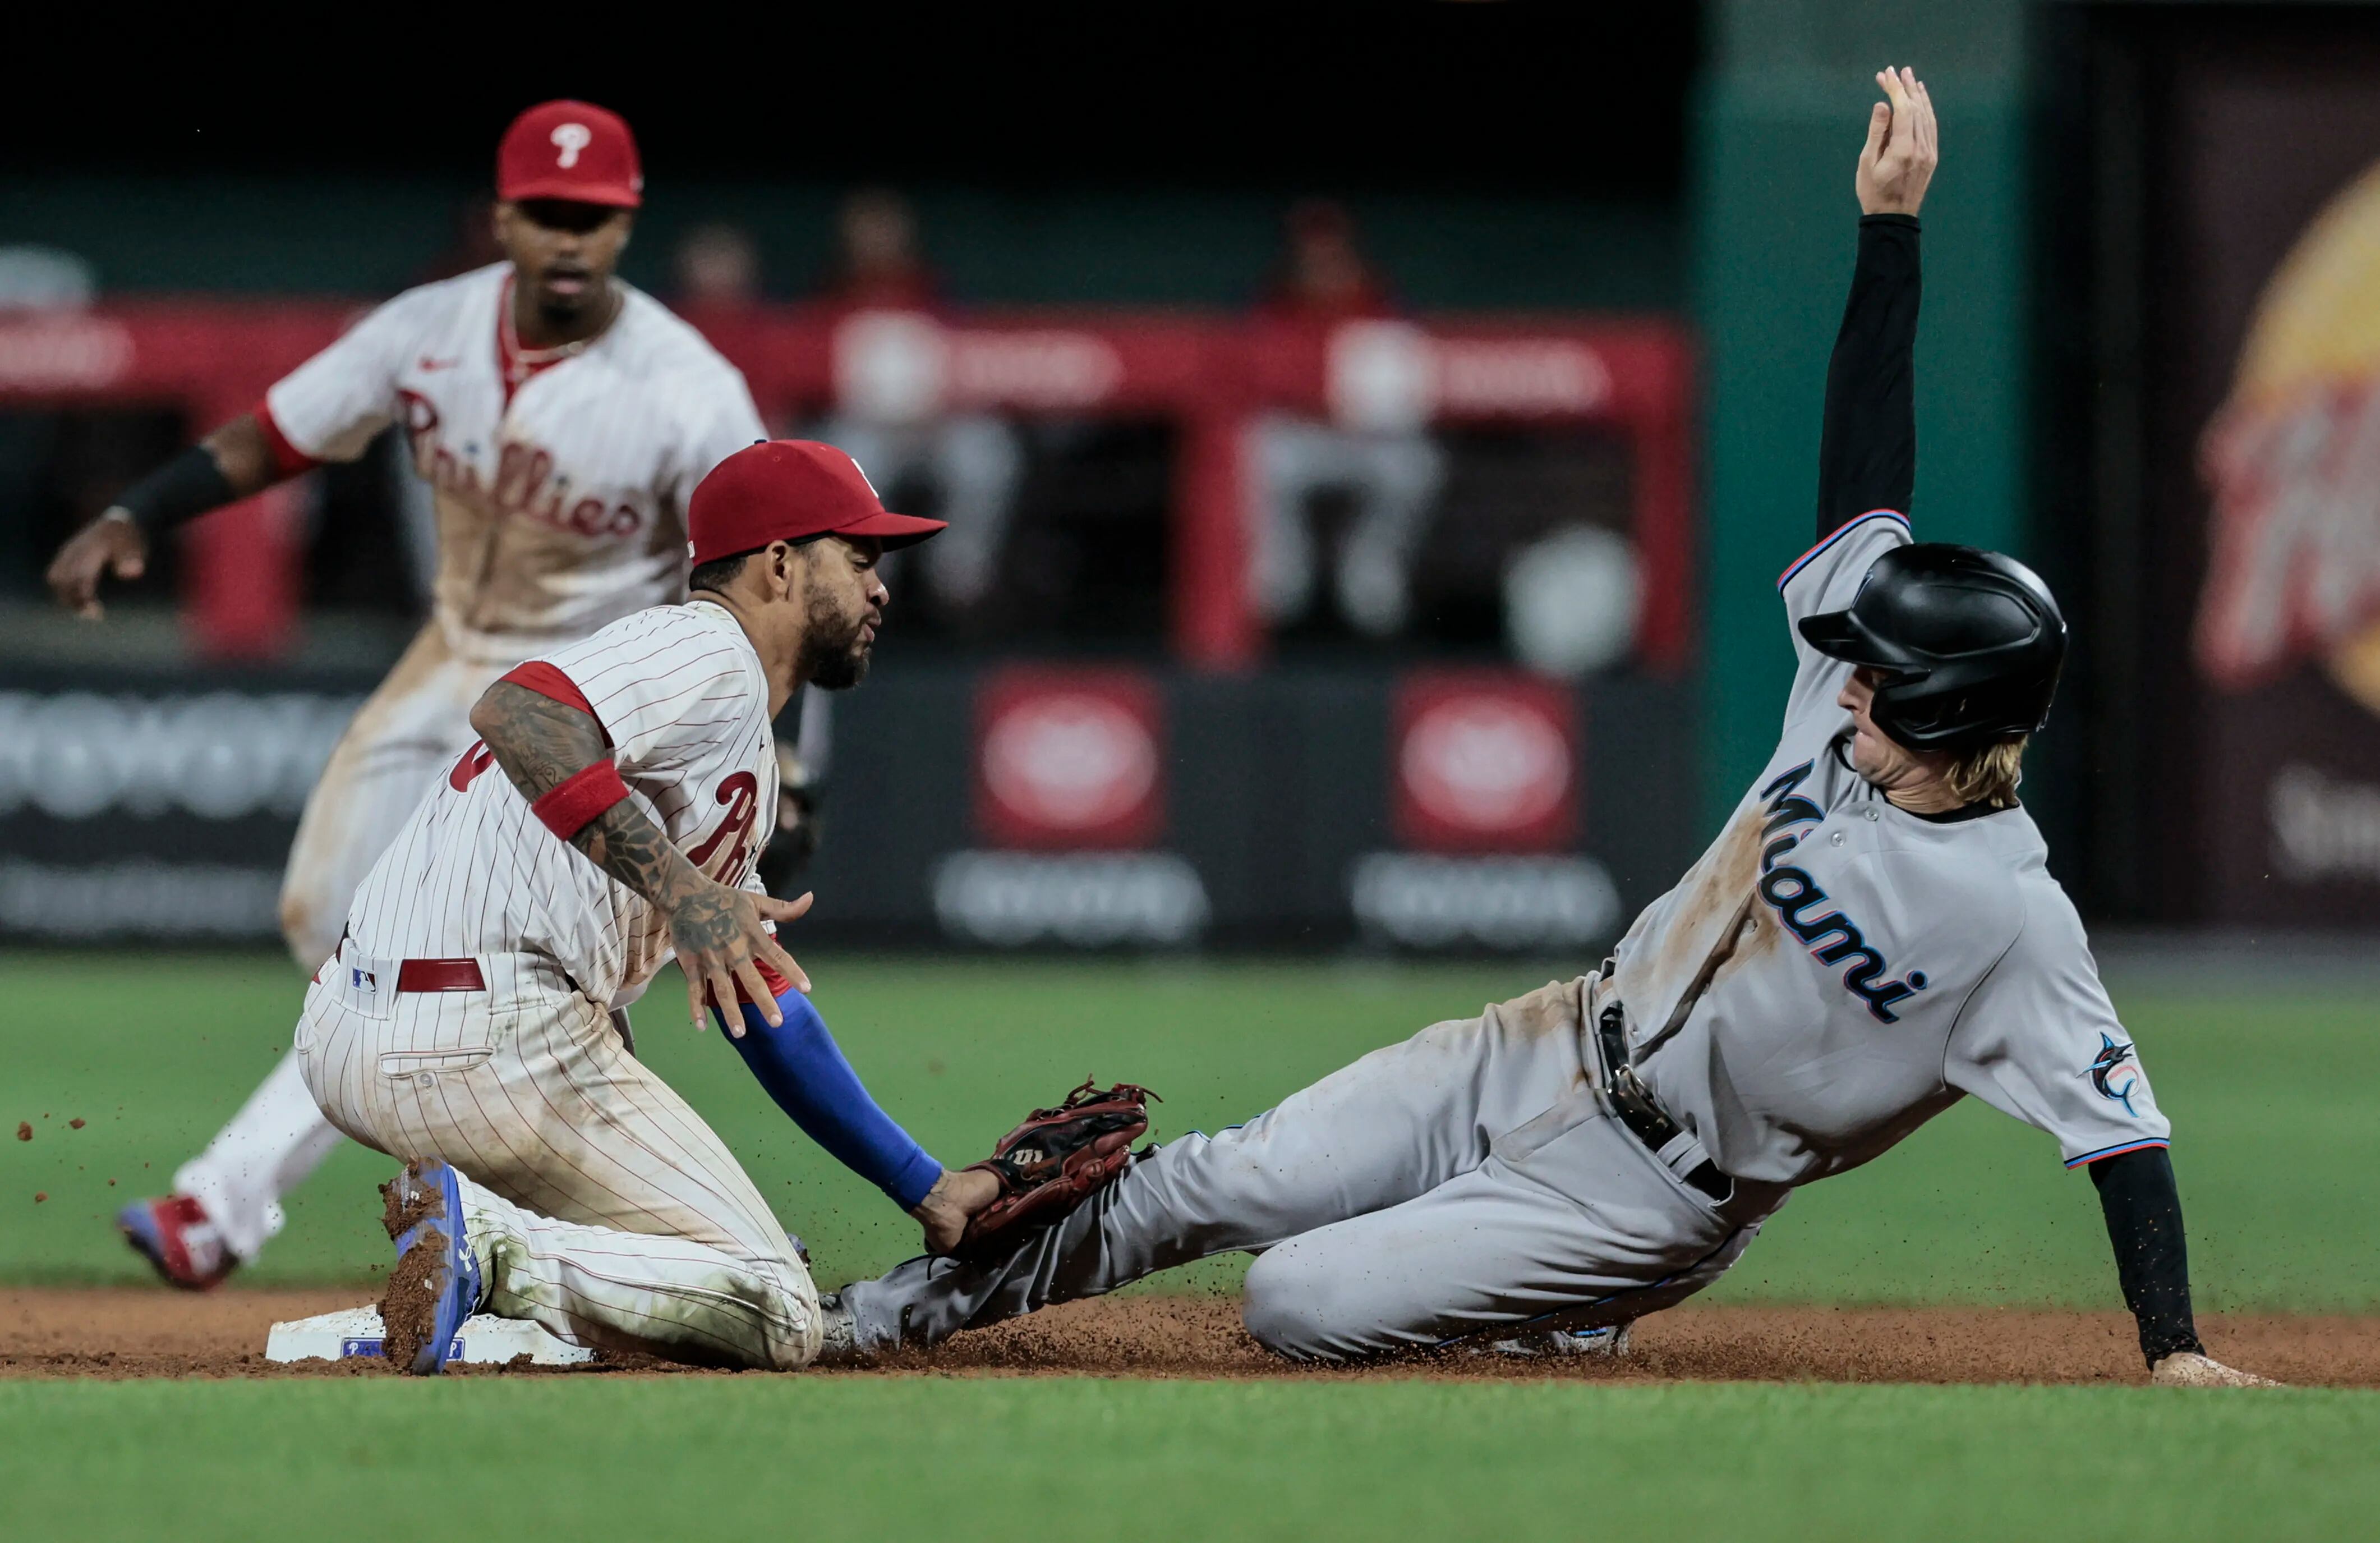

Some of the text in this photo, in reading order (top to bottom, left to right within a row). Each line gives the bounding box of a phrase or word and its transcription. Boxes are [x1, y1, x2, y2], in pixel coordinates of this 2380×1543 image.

[550, 122, 592, 169] P
[397, 389, 641, 539] Phillies
[1756, 757, 1928, 1025] Miami
